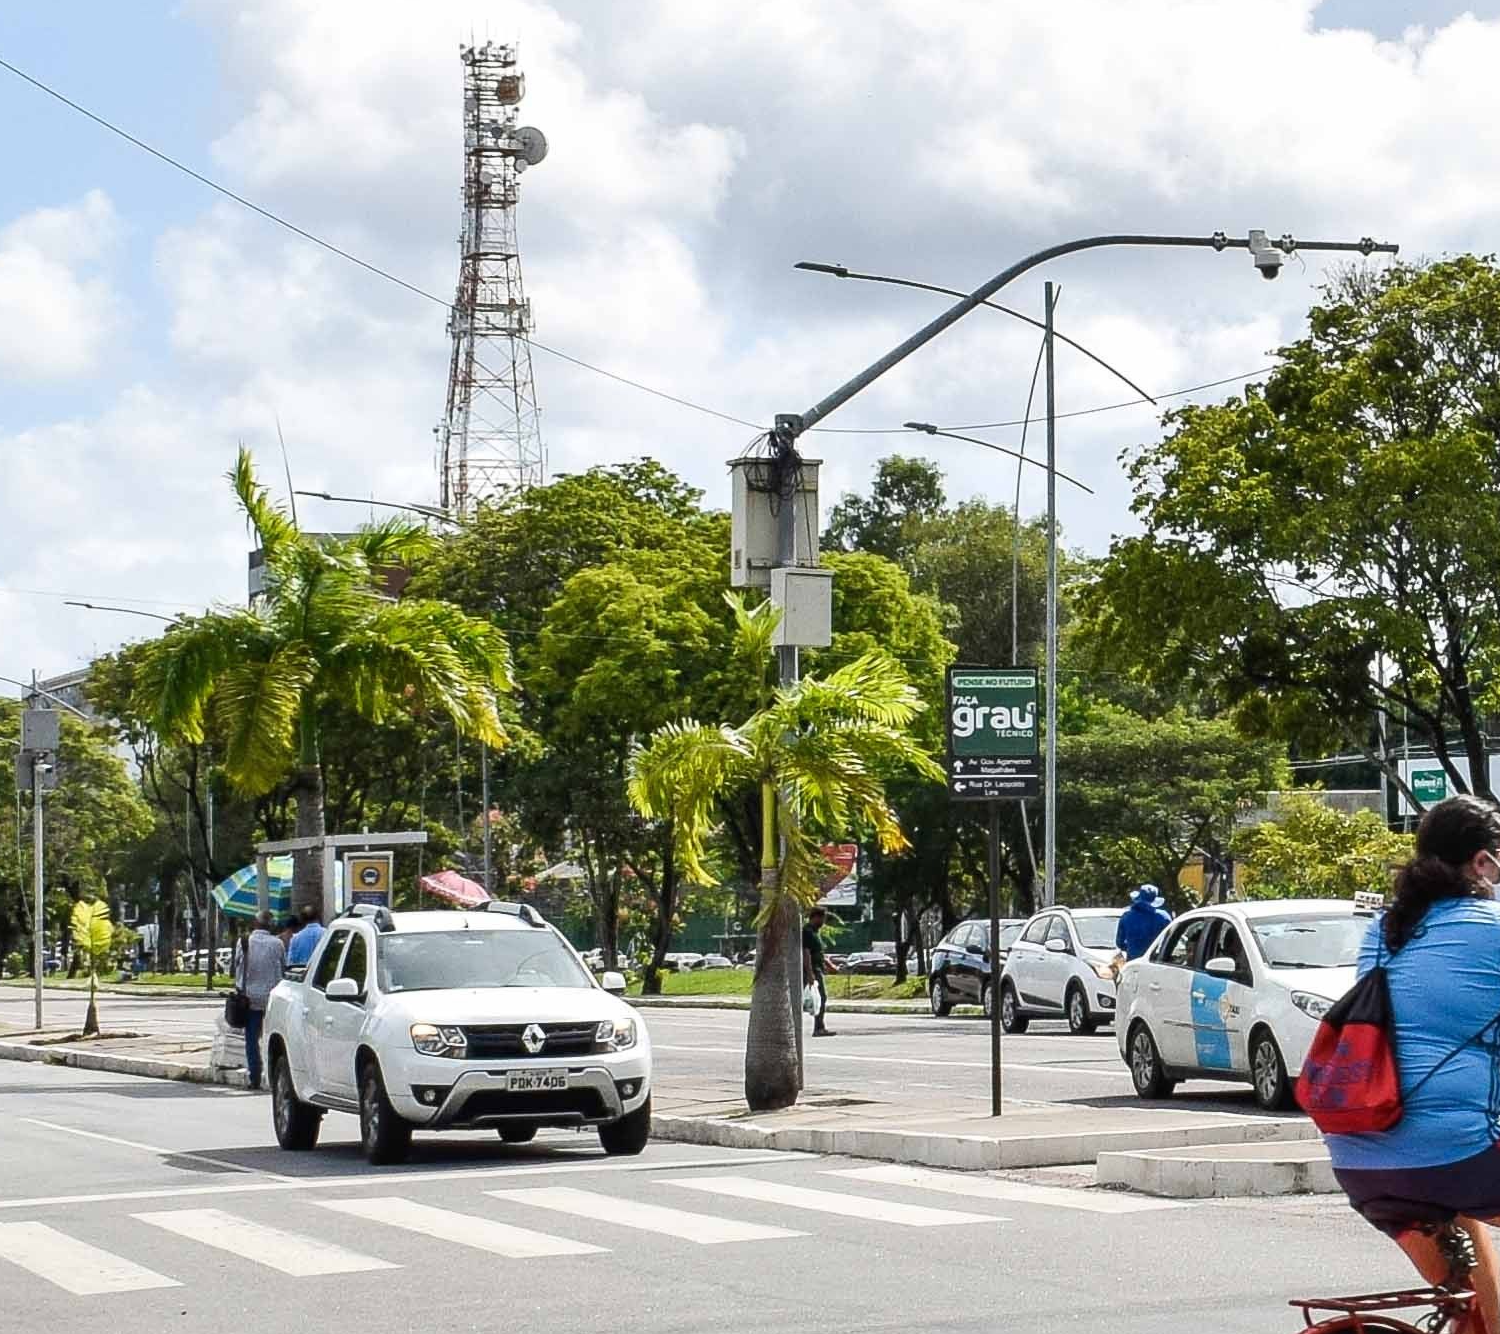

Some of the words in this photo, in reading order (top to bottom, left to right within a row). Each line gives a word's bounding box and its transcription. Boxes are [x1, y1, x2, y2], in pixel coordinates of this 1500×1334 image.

[953, 695, 979, 707] FAÇA
[952, 705, 1034, 738] grau
[968, 780, 983, 788] Rua
